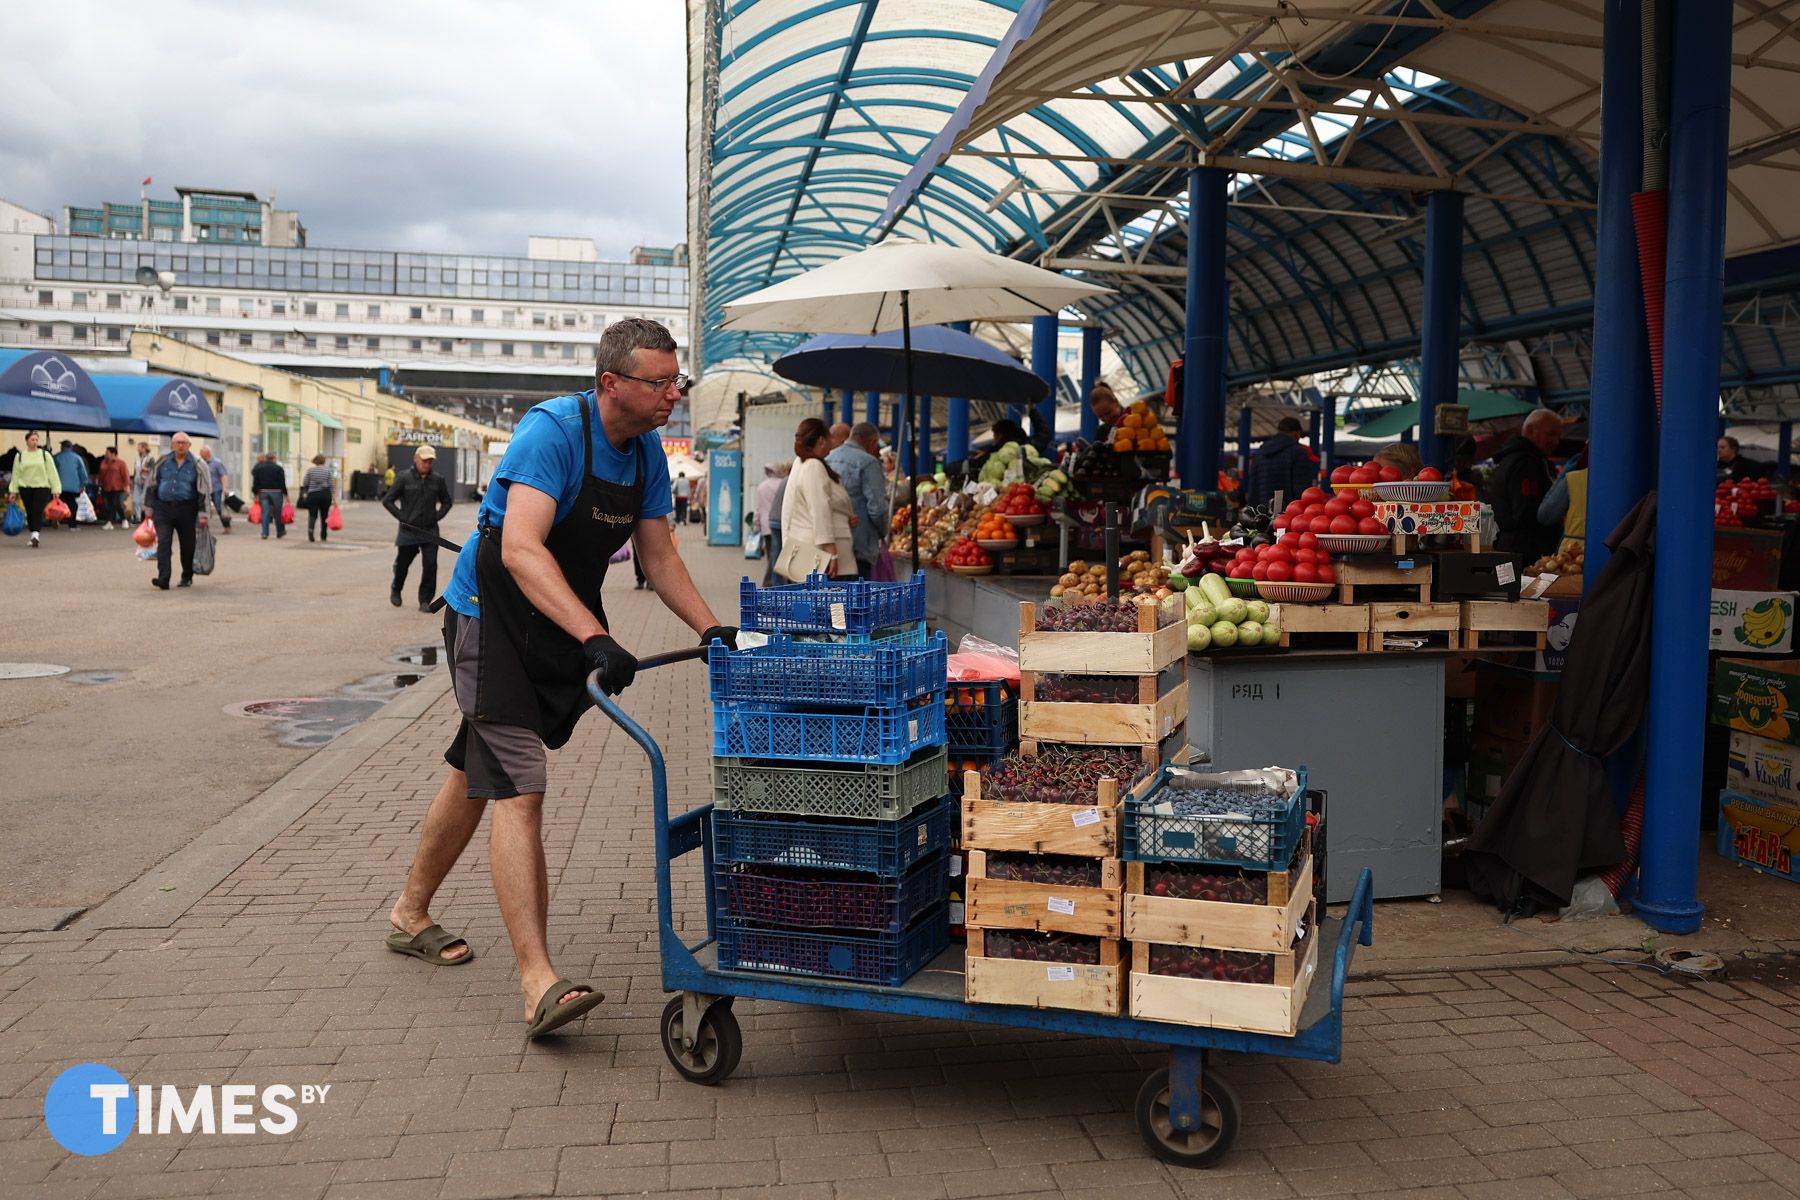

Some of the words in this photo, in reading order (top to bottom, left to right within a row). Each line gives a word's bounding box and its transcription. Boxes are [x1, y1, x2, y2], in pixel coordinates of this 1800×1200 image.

[1232, 683, 1263, 701] РЯД
[1755, 760, 1792, 791] BONITA
[1730, 799, 1764, 816] PREMIUM
[1766, 809, 1800, 827] BANANA
